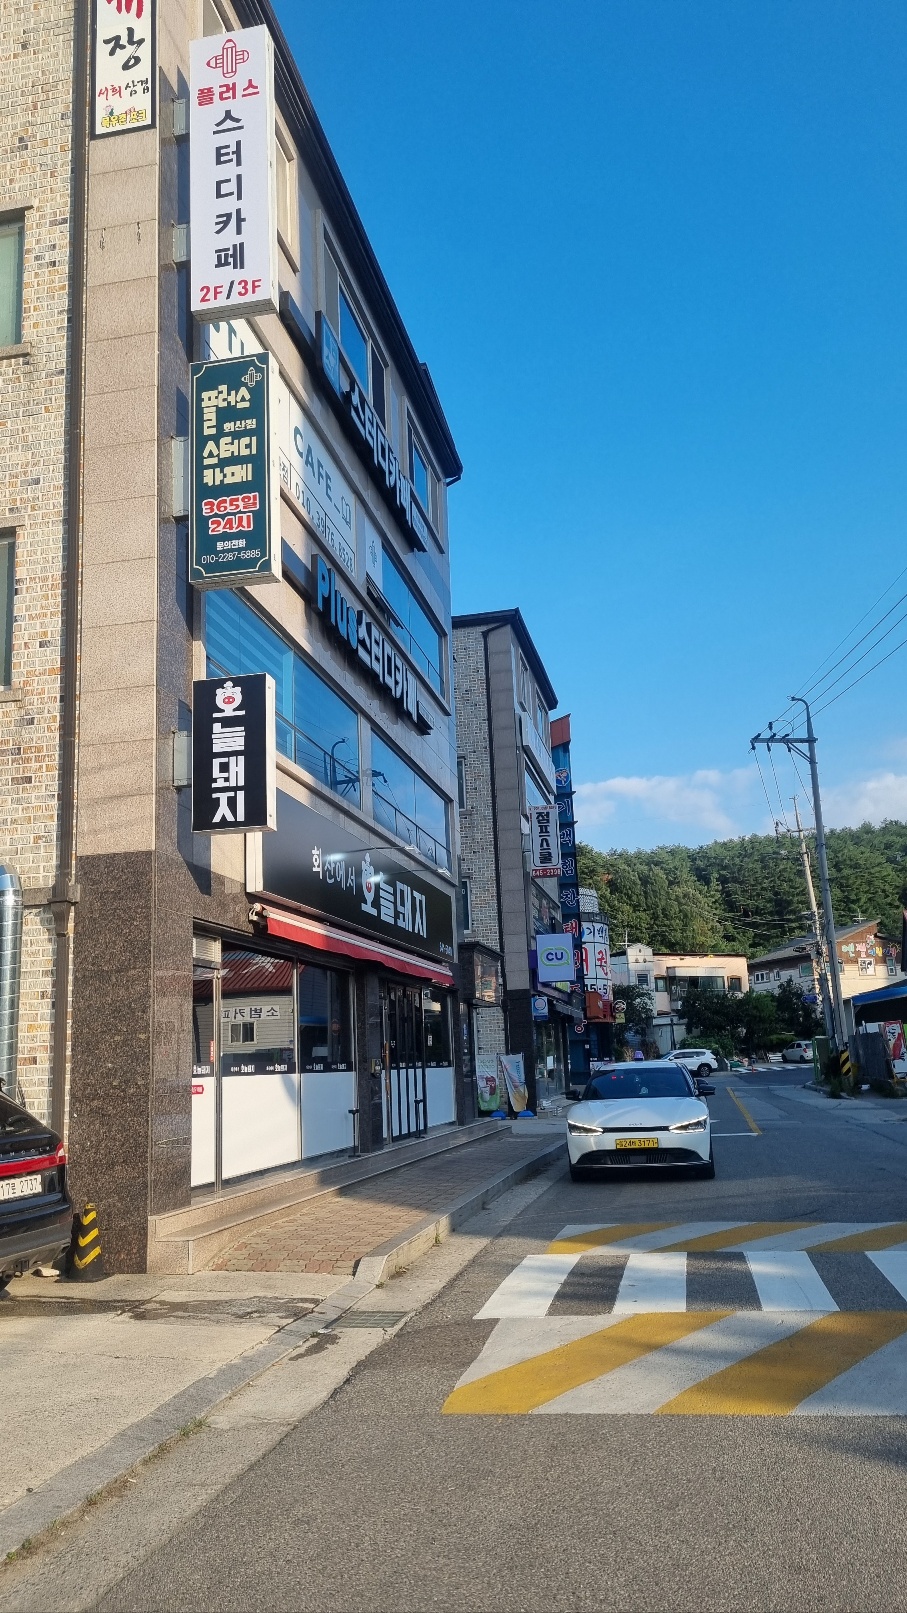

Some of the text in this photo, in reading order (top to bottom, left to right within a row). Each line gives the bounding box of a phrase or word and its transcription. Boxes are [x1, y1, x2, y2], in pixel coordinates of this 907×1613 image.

[98, 78, 150, 101] 서희 삼겹
[196, 78, 260, 107] 플러스
[212, 109, 247, 270] 스터디카페
[199, 278, 262, 303] 2F/3F
[201, 384, 251, 437] 플러스
[223, 418, 257, 433] 회산점
[202, 436, 257, 466] 스터디
[350, 382, 412, 528] 스터디카페
[203, 463, 253, 487] 카페
[201, 492, 260, 517] 365일
[209, 513, 254, 535] 24시
[216, 538, 247, 551] 문의전화
[535, 811, 553, 865] 점프스쿨
[311, 845, 356, 896] 회산에서
[545, 951, 564, 961] CU
[637, 1139, 655, 1147] 3171
[19, 1177, 38, 1193] 2737
